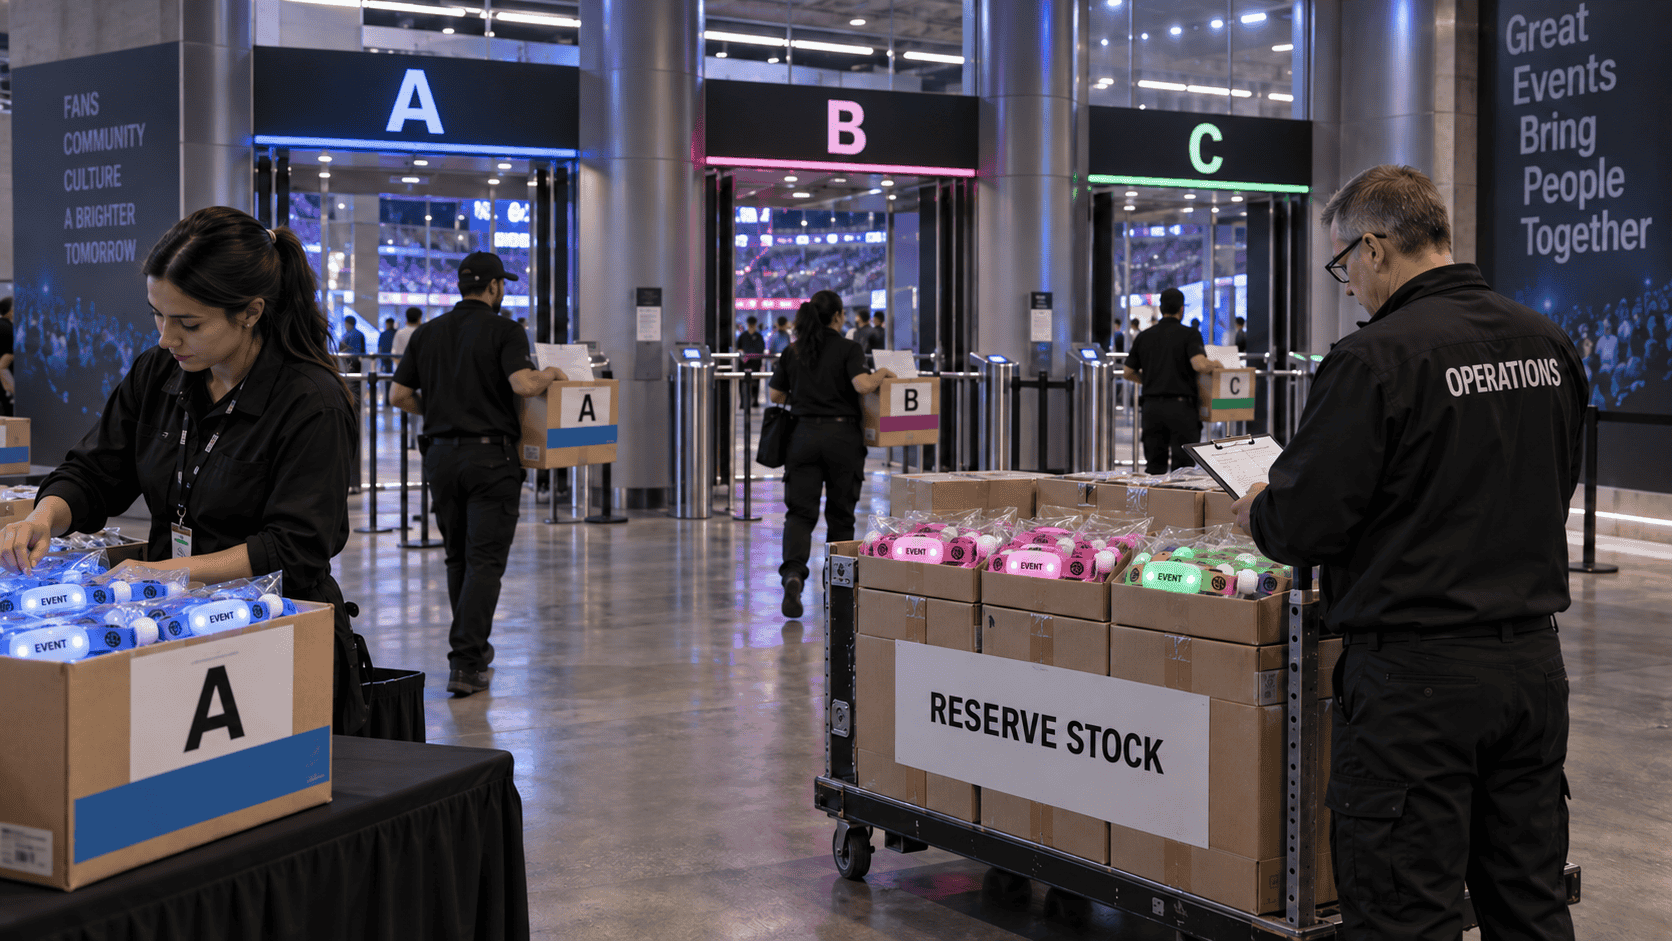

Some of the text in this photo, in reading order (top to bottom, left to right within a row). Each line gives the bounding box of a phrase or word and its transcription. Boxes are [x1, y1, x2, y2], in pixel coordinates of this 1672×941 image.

[1506, 3, 1590, 56] Great
[1512, 54, 1617, 106] Events
[63, 91, 100, 120] FANS
[386, 68, 445, 134] A
[63, 123, 146, 155] COMMUNITY
[827, 99, 866, 155] B
[1520, 111, 1597, 158] Bring
[1189, 123, 1223, 174] C
[63, 164, 122, 192] CULTURE
[1523, 157, 1625, 210] People
[63, 203, 136, 230] A BRIGHTER
[1521, 210, 1653, 263] Together
[64, 239, 137, 265] TOMORROW
[1230, 376, 1240, 395] C
[1445, 358, 1562, 397] OPERATIONS
[578, 393, 596, 422] A
[904, 388, 919, 412] B
[905, 547, 926, 556] EVENT
[1020, 561, 1043, 571] EVENT
[1157, 572, 1182, 583] EVENT
[41, 594, 67, 606] EVENT
[209, 611, 234, 624] EVENT
[34, 639, 67, 653] EVENT
[183, 664, 245, 753] A
[930, 691, 1165, 775] RESERVE STOCK
